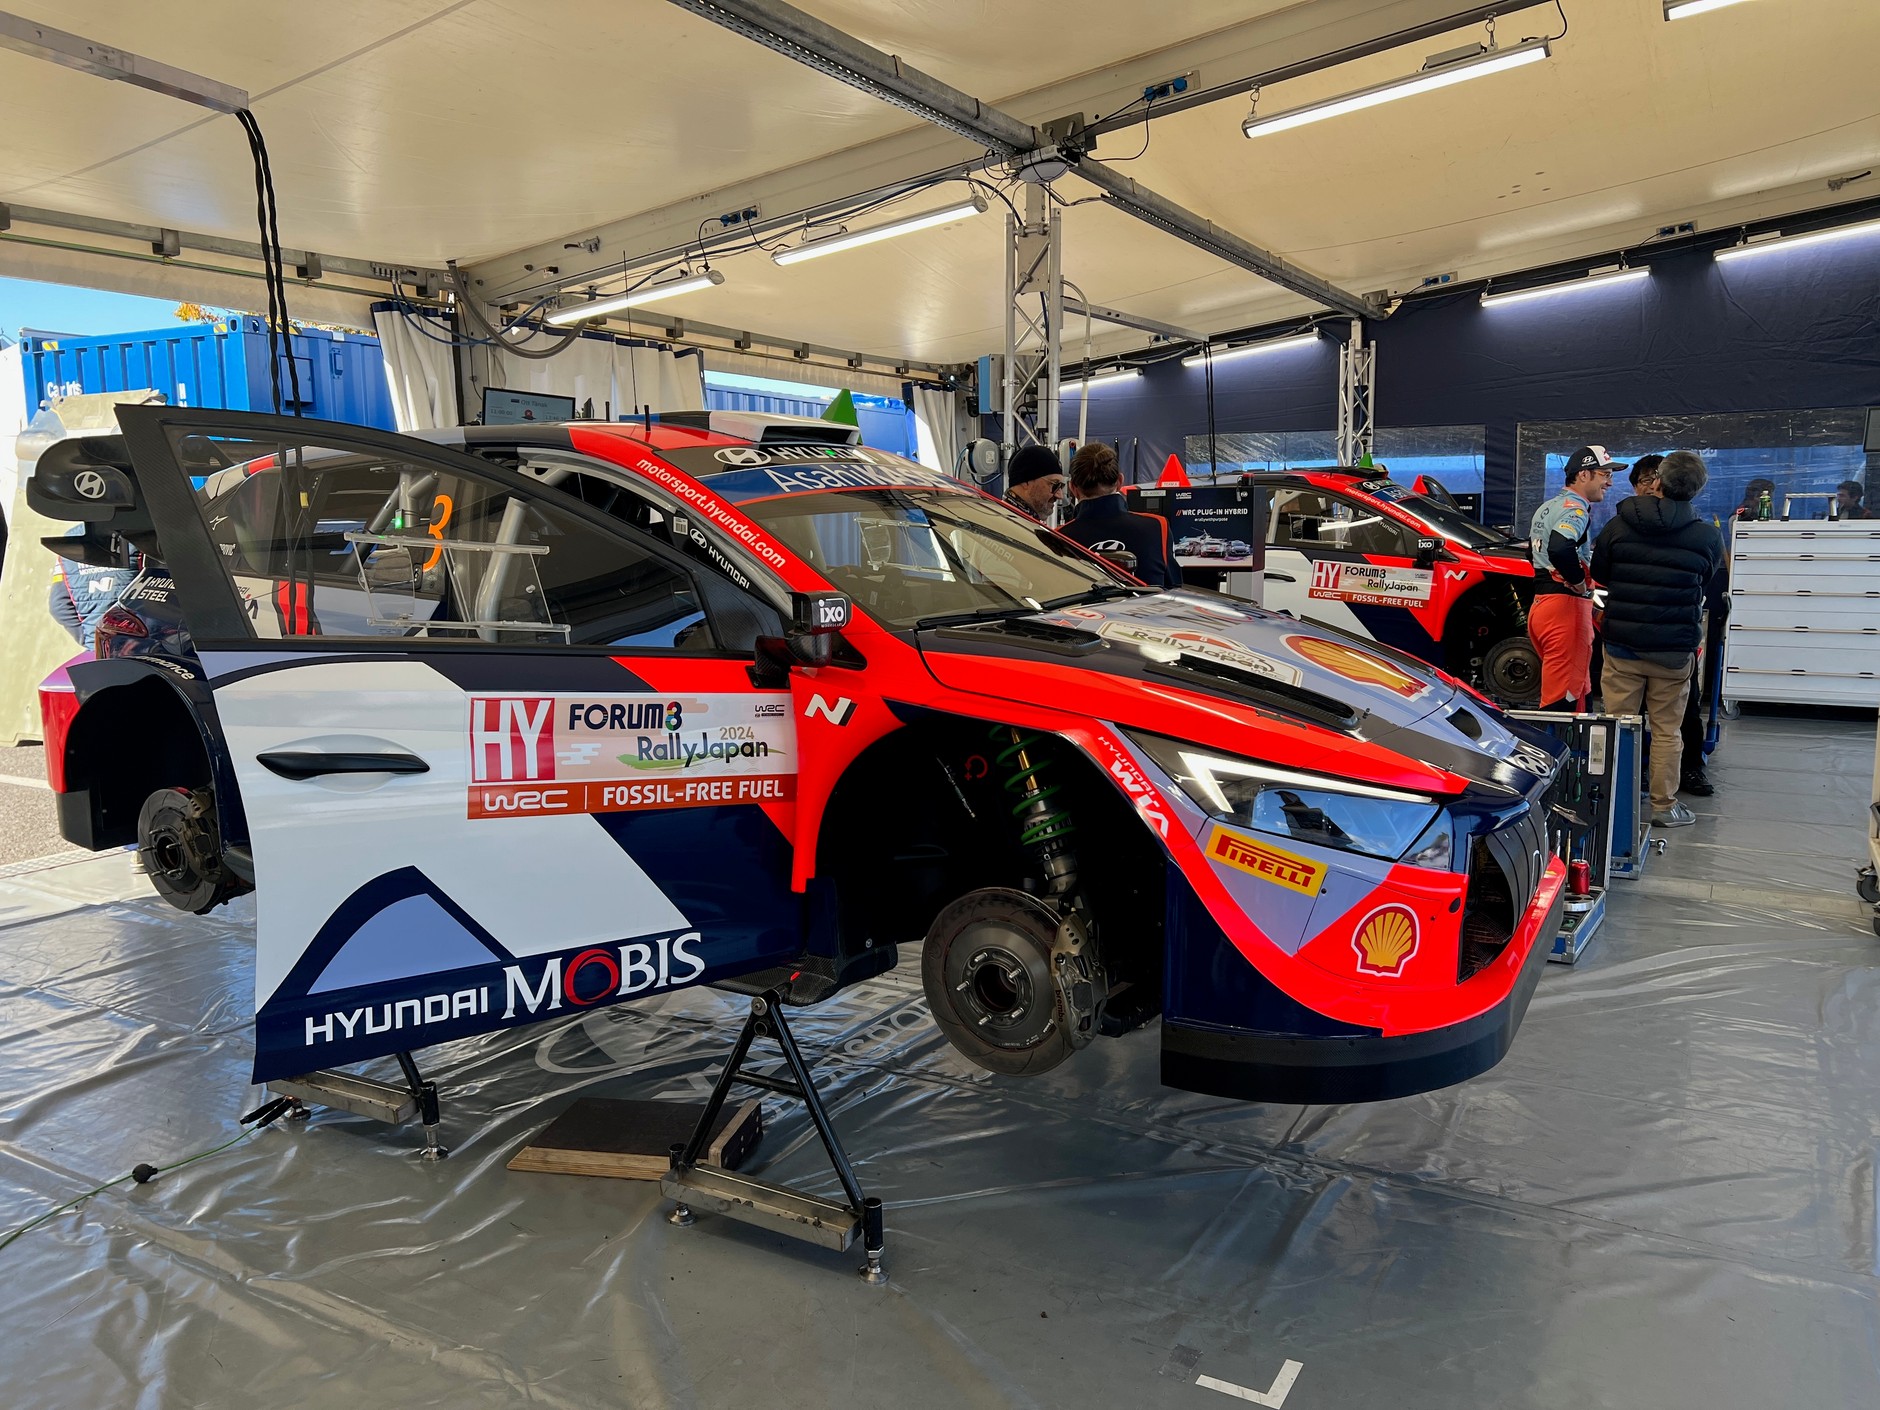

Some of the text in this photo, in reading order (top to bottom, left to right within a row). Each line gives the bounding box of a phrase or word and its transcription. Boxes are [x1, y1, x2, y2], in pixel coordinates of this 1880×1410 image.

[636, 458, 788, 570] motorsport.hyundai.com
[1197, 508, 1223, 516] PLUG-IN
[422, 494, 453, 572] 3
[707, 545, 750, 590] HYUNDAI
[1313, 562, 1340, 589] HY
[139, 590, 169, 602] STEEL
[818, 599, 846, 624] ixo
[1352, 593, 1402, 606] FOSSIL-FREE
[1403, 599, 1424, 608] FUEL
[569, 701, 683, 731] FORUM8
[755, 704, 785, 713] WRC
[473, 699, 553, 781] HY
[719, 726, 755, 741] 2024
[1097, 735, 1157, 797] HYUNDAI
[484, 779, 784, 812] WRC FOSSIL-FREE FUEL
[1215, 833, 1316, 888] PIRELLI
[304, 932, 706, 1047] HYUNDAI MOBIS
